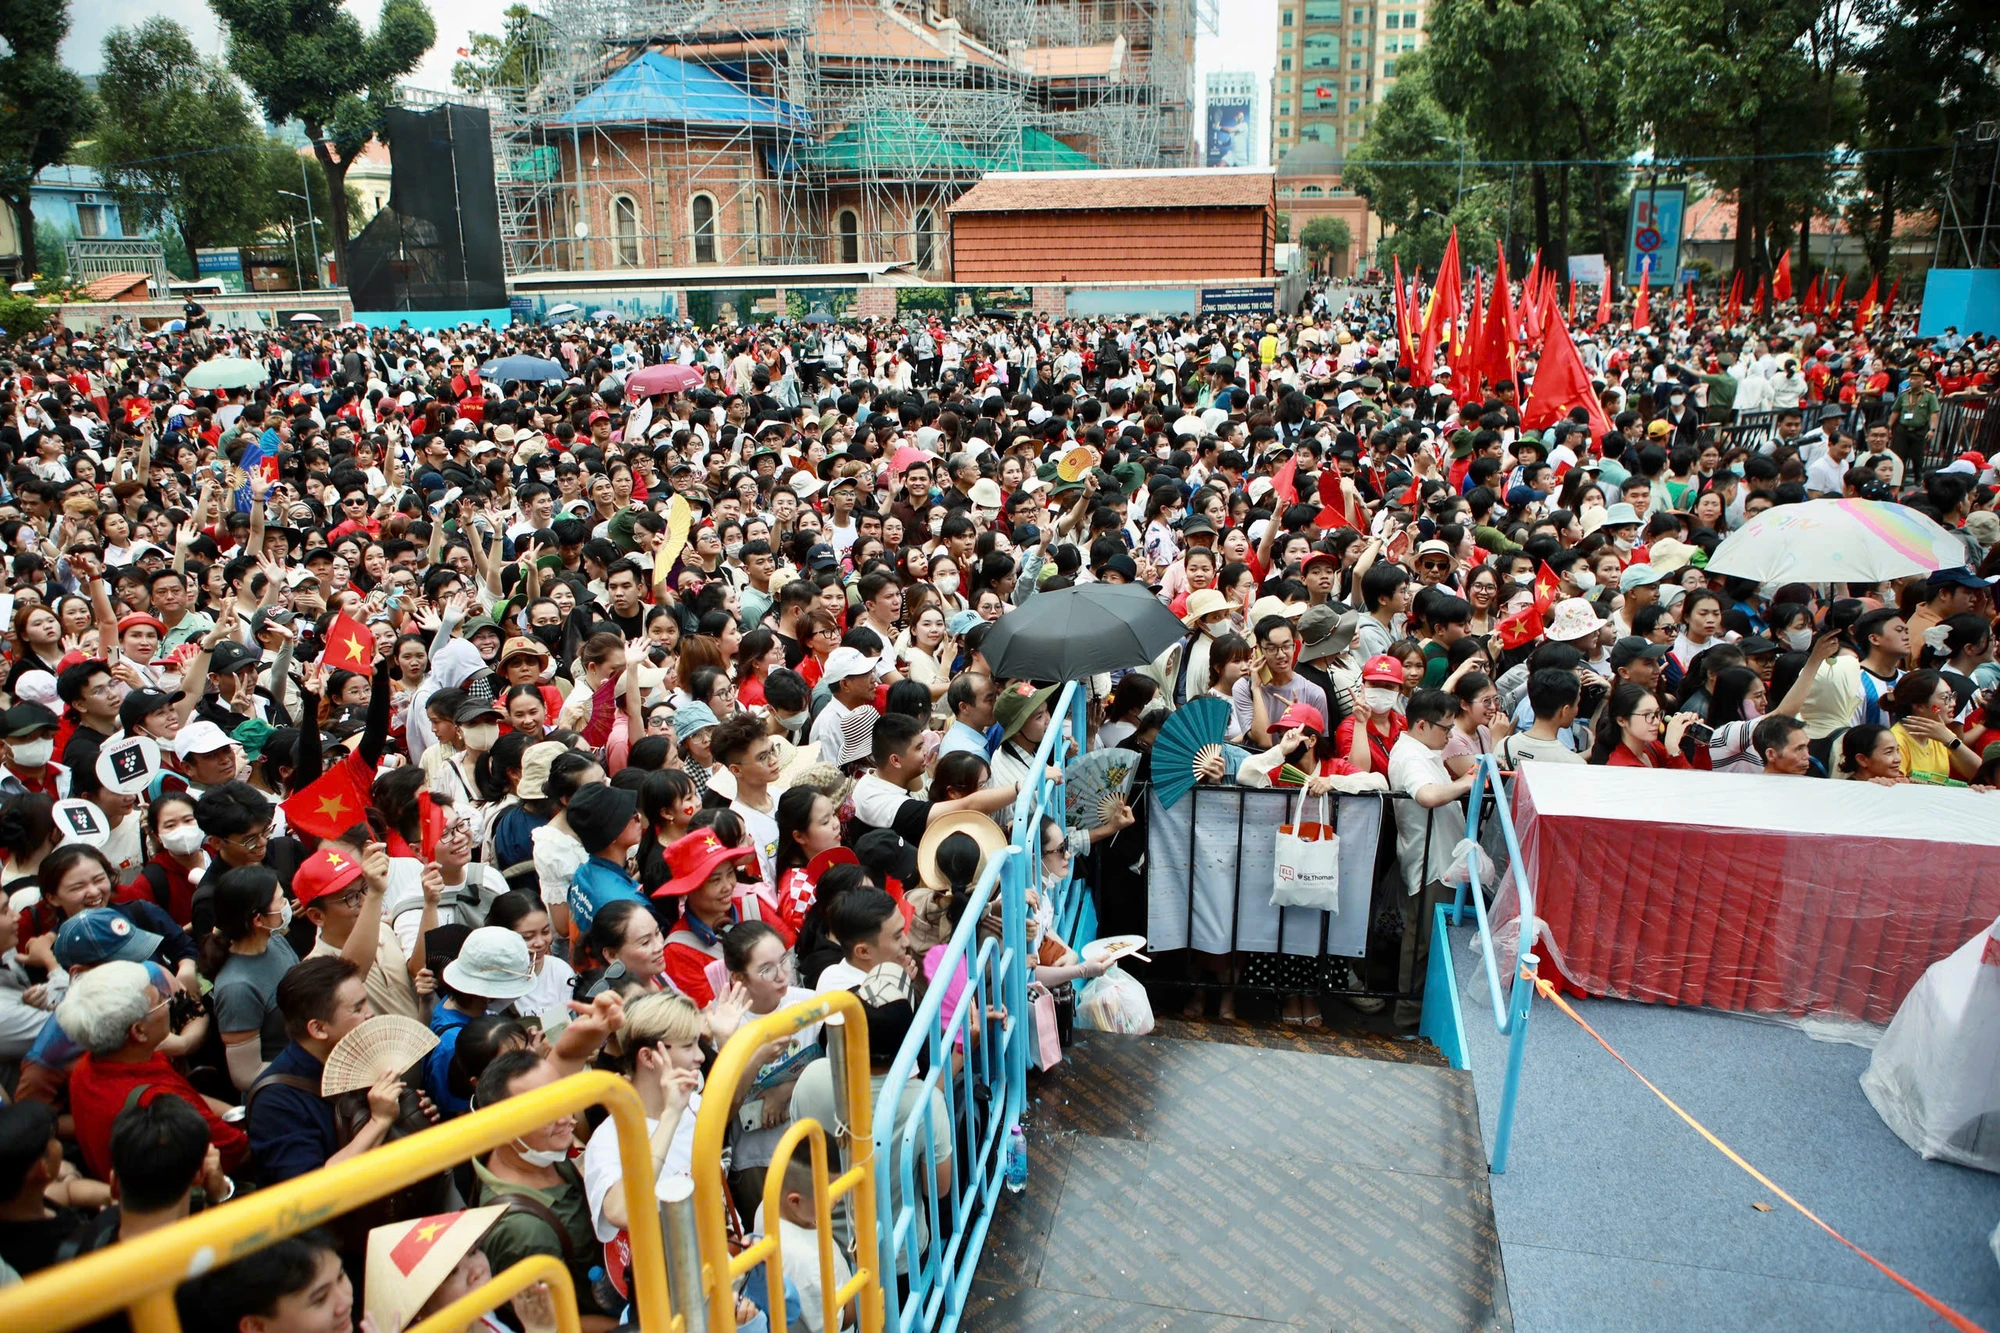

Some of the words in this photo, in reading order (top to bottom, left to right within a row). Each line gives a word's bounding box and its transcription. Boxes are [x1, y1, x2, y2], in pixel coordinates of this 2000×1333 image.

[1208, 98, 1249, 106] HUBLOT
[110, 739, 137, 752] SHARP
[1282, 868, 1291, 876] ELS
[1334, 1196, 1364, 1218] PHAT
[1359, 1213, 1394, 1238] NGOC
[1419, 1219, 1454, 1245] DONA
[1425, 1256, 1460, 1283] PHAT
